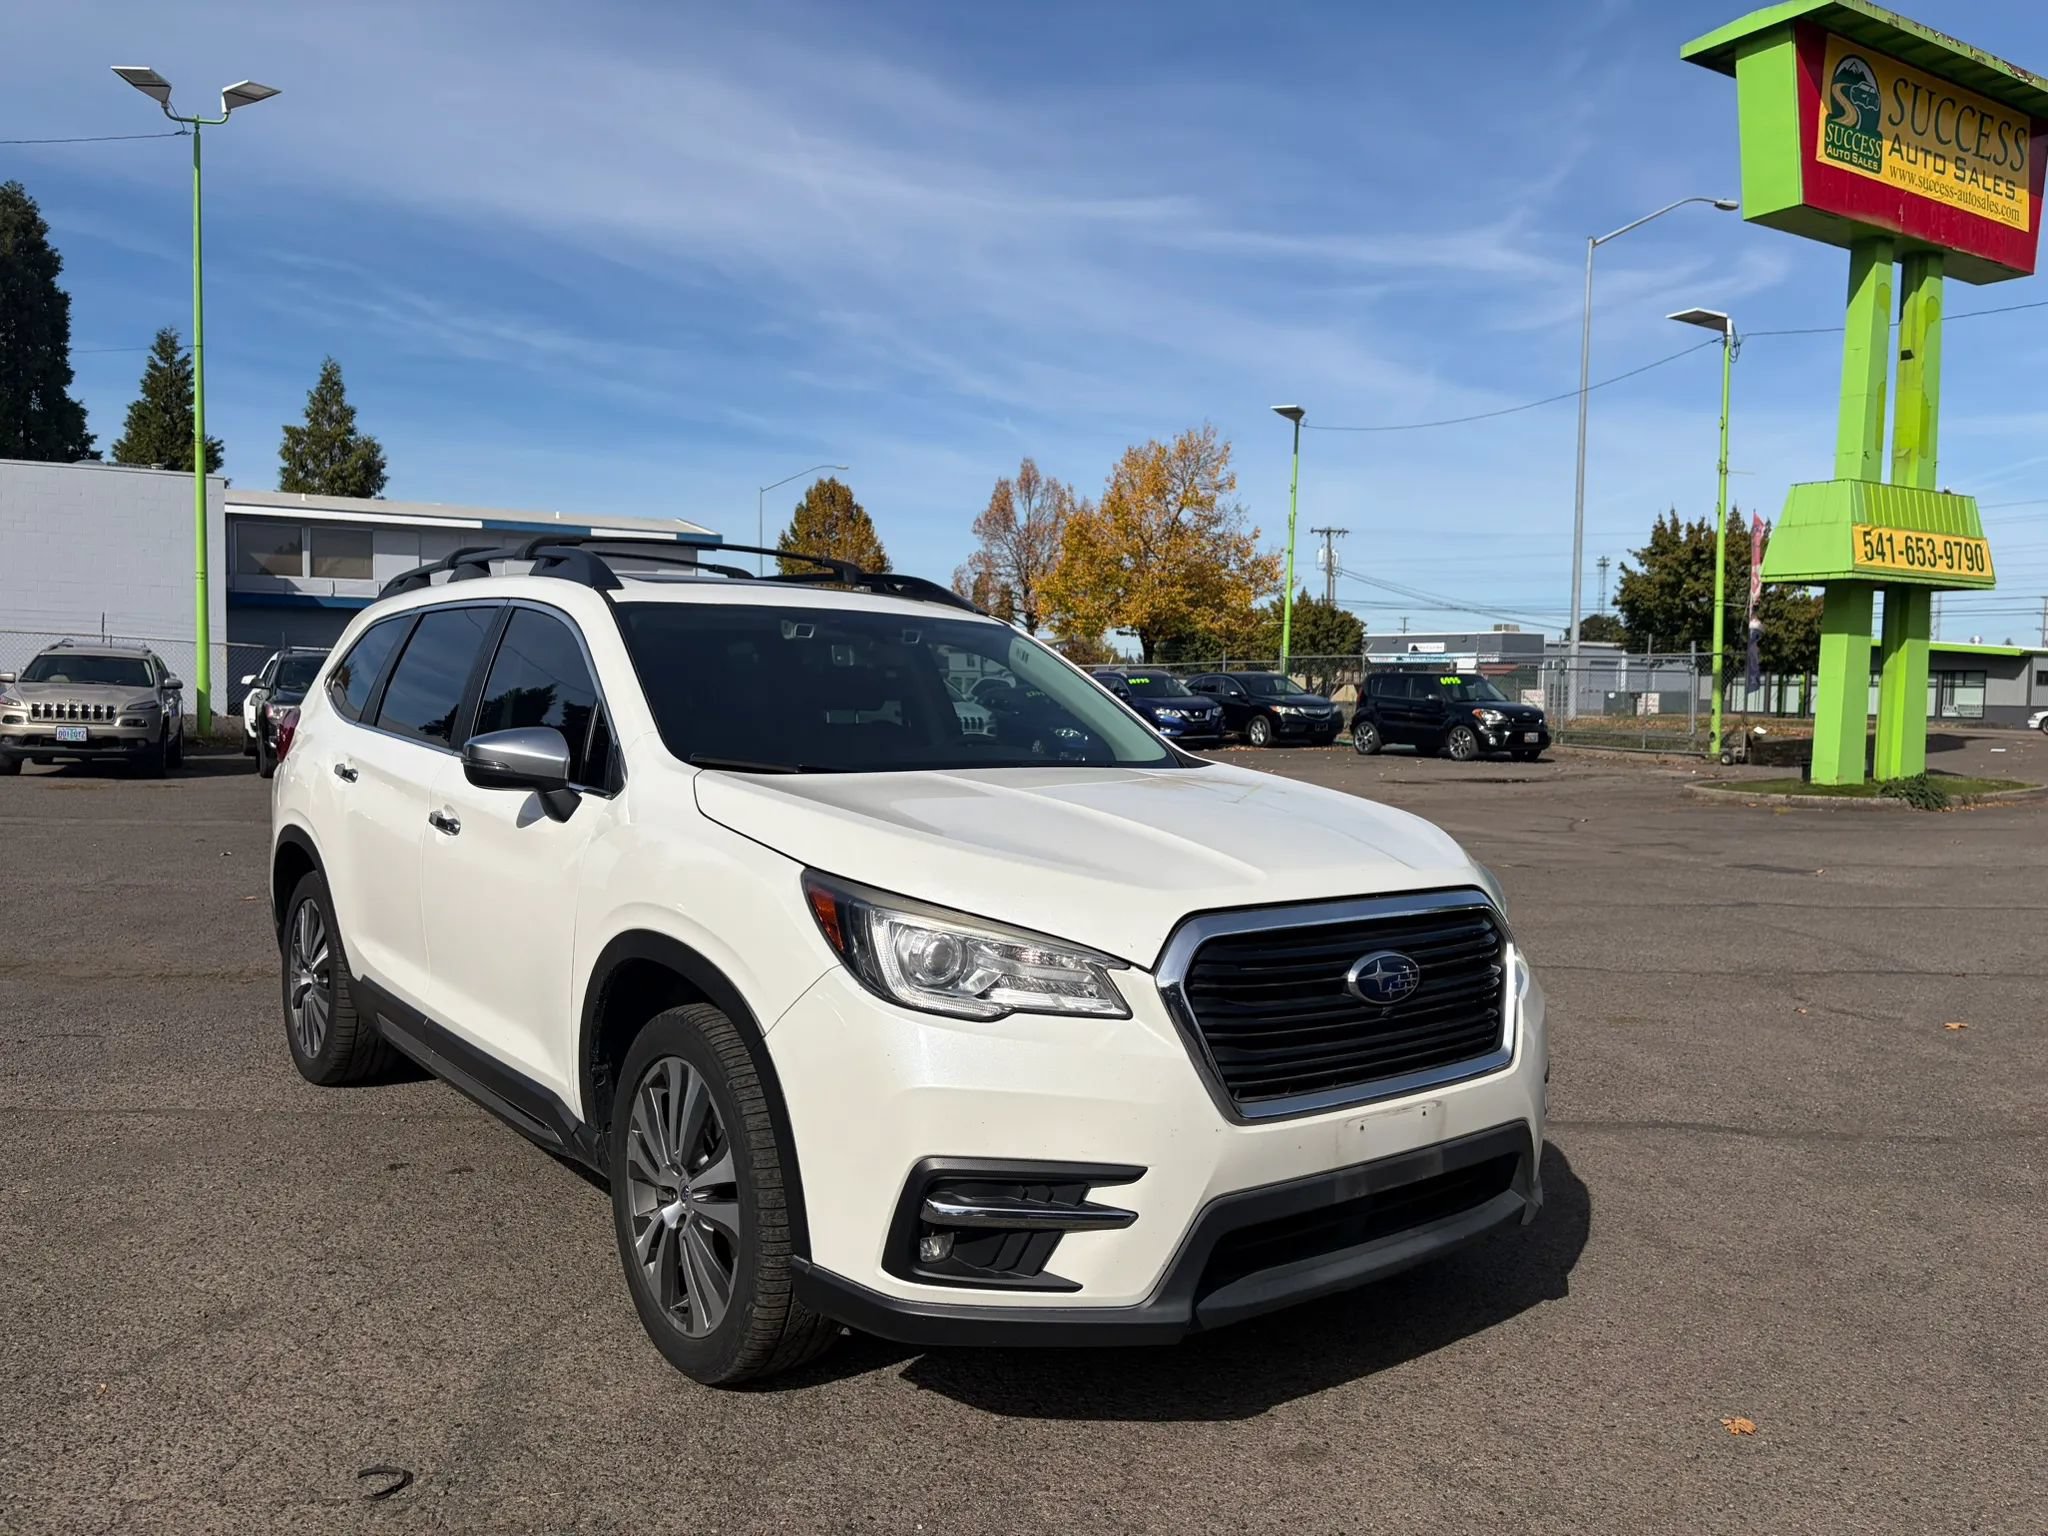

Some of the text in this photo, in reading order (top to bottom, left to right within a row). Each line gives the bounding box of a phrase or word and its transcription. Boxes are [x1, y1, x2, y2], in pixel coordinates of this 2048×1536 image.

[1825, 123, 1882, 159] SUCCESS
[1887, 78, 2027, 172] SUCCESS
[1826, 144, 1878, 170] AUTO SALES
[1888, 133, 2017, 201] AUTO SALES
[1889, 164, 2020, 222] www.success-autosales.com
[1863, 530, 1985, 573] 541-653-9790
